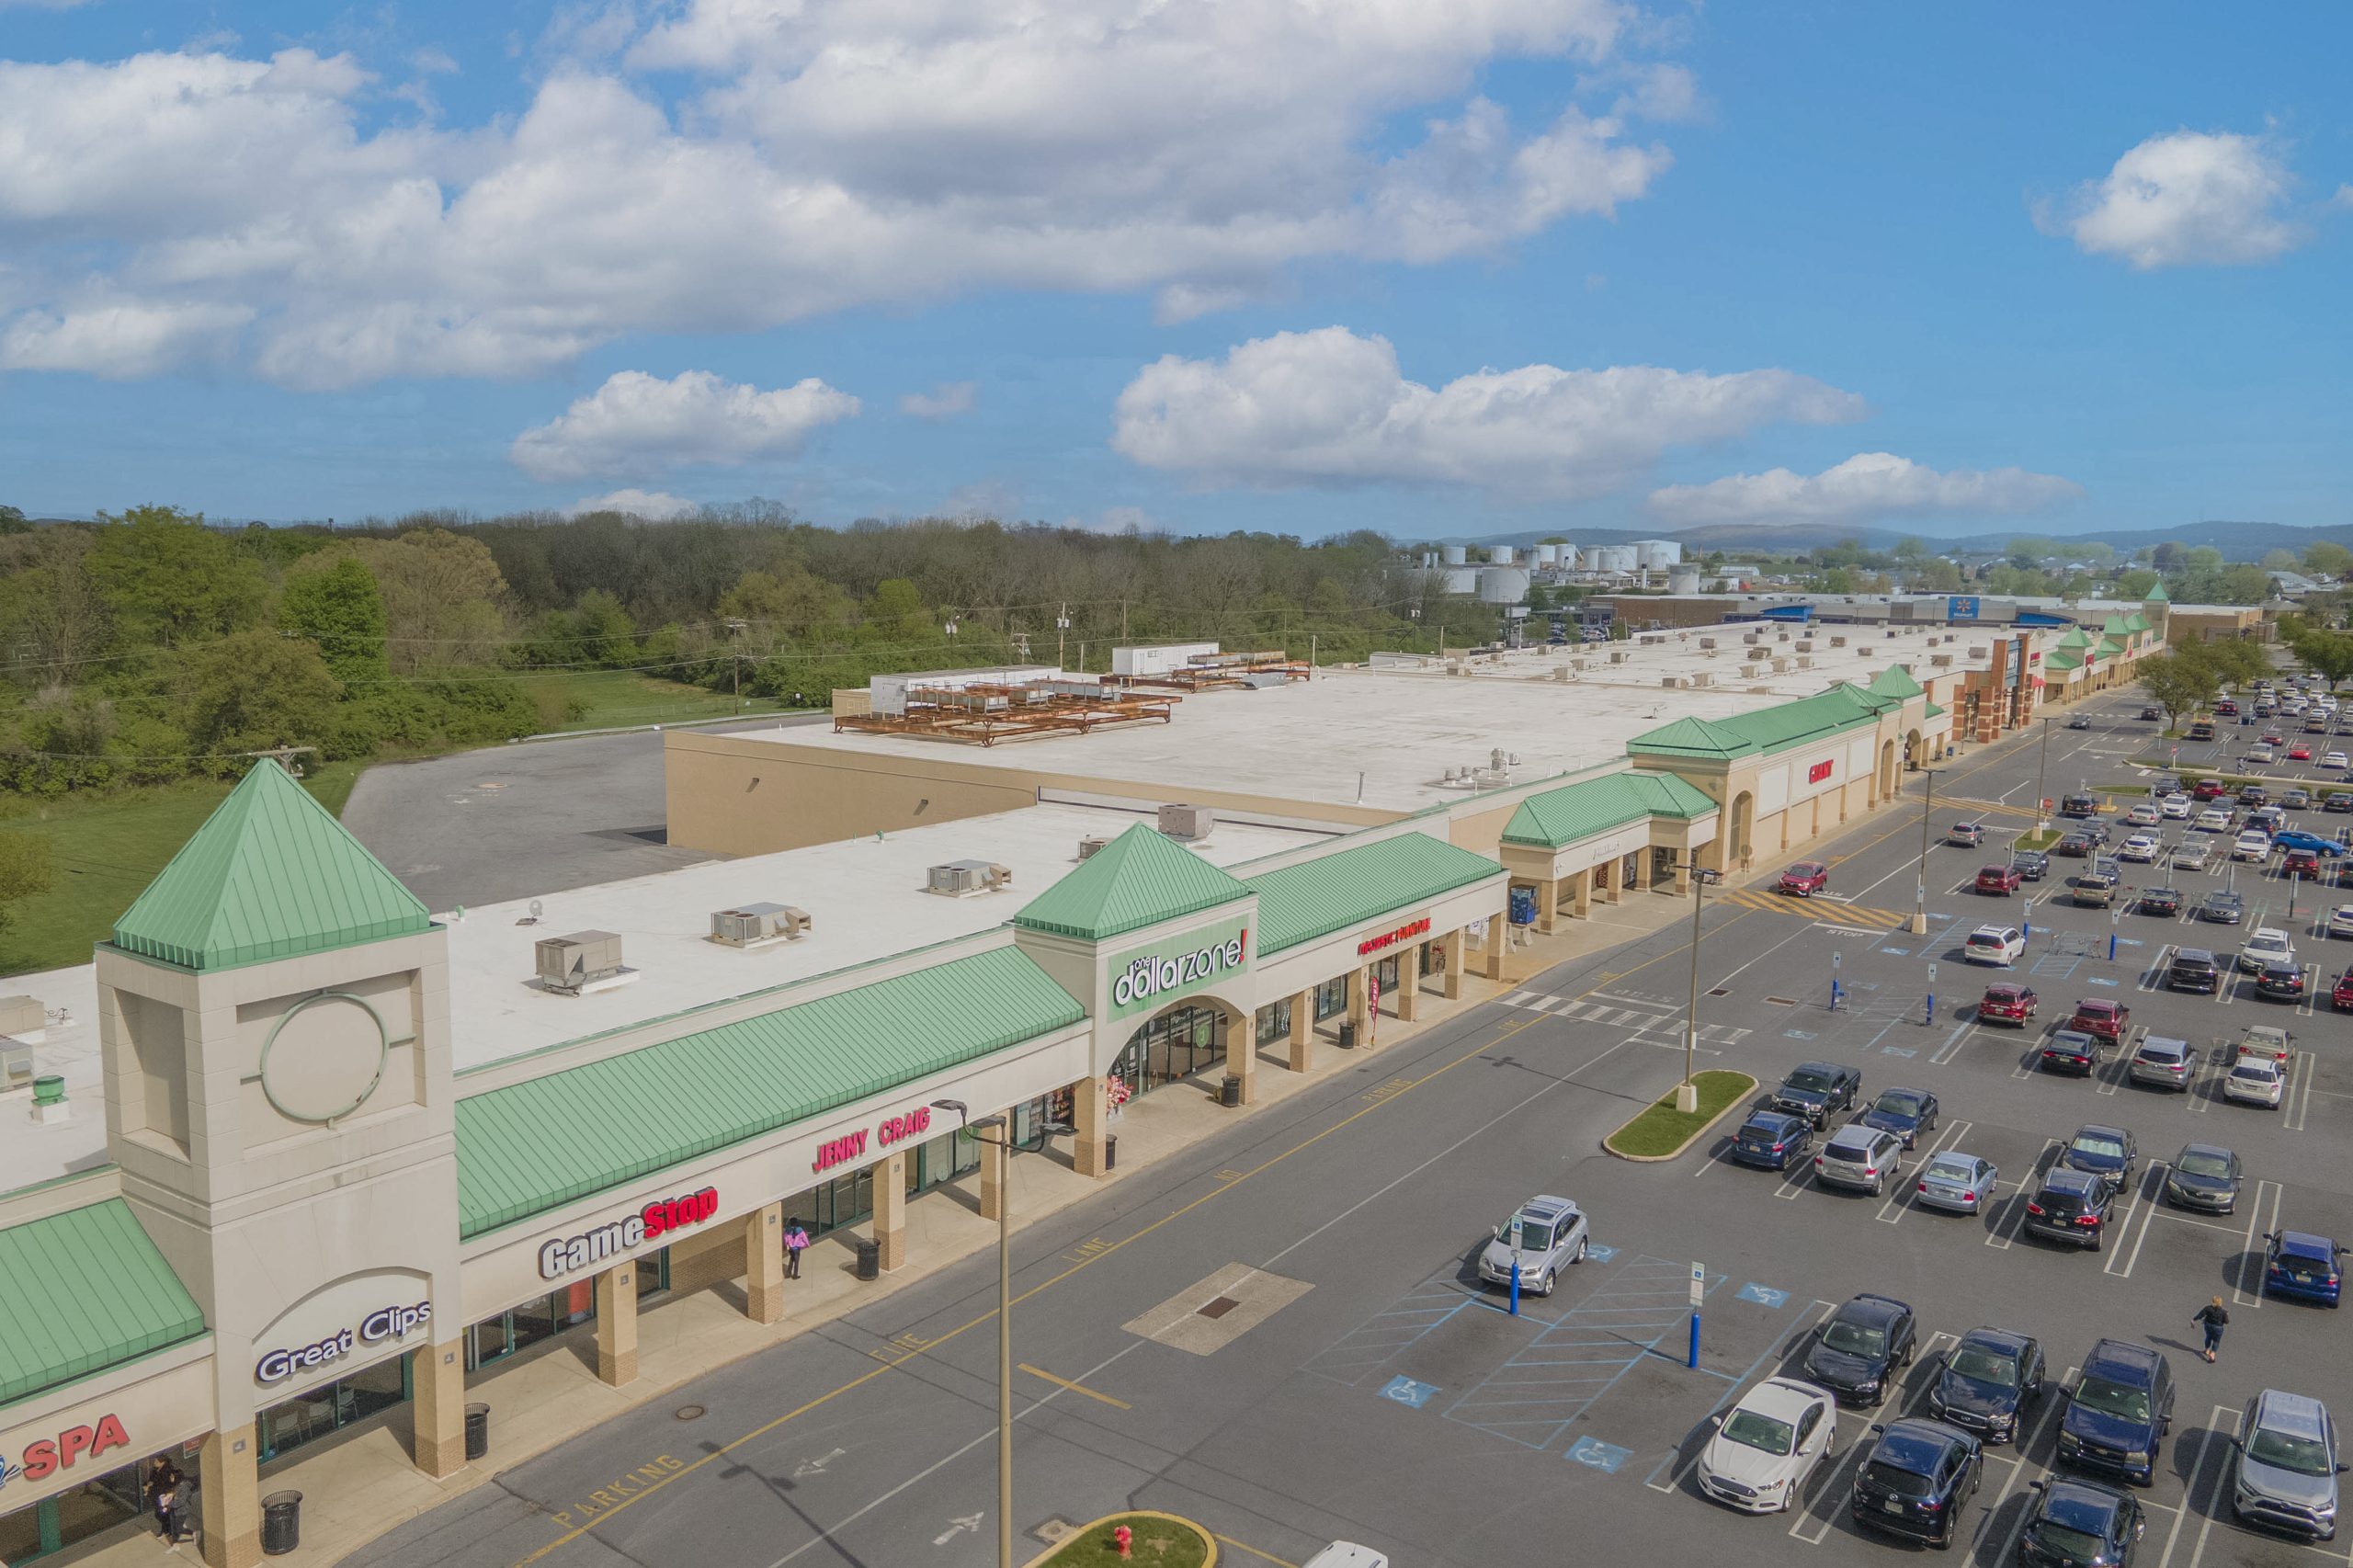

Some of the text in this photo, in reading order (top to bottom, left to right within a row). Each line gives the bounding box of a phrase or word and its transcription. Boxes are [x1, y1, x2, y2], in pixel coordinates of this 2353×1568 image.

[1826, 929, 1865, 937] STOP
[1132, 957, 1151, 971] one
[812, 1107, 930, 1174] JENNY CRAIG
[1213, 1169, 1241, 1184] NO
[538, 1186, 719, 1280] GameStop
[1062, 1237, 1115, 1263] LANE
[256, 1301, 431, 1382] Great Clips
[867, 1333, 928, 1362] FIRE
[23, 1413, 131, 1482] SPA
[551, 1454, 685, 1529] PARKING
